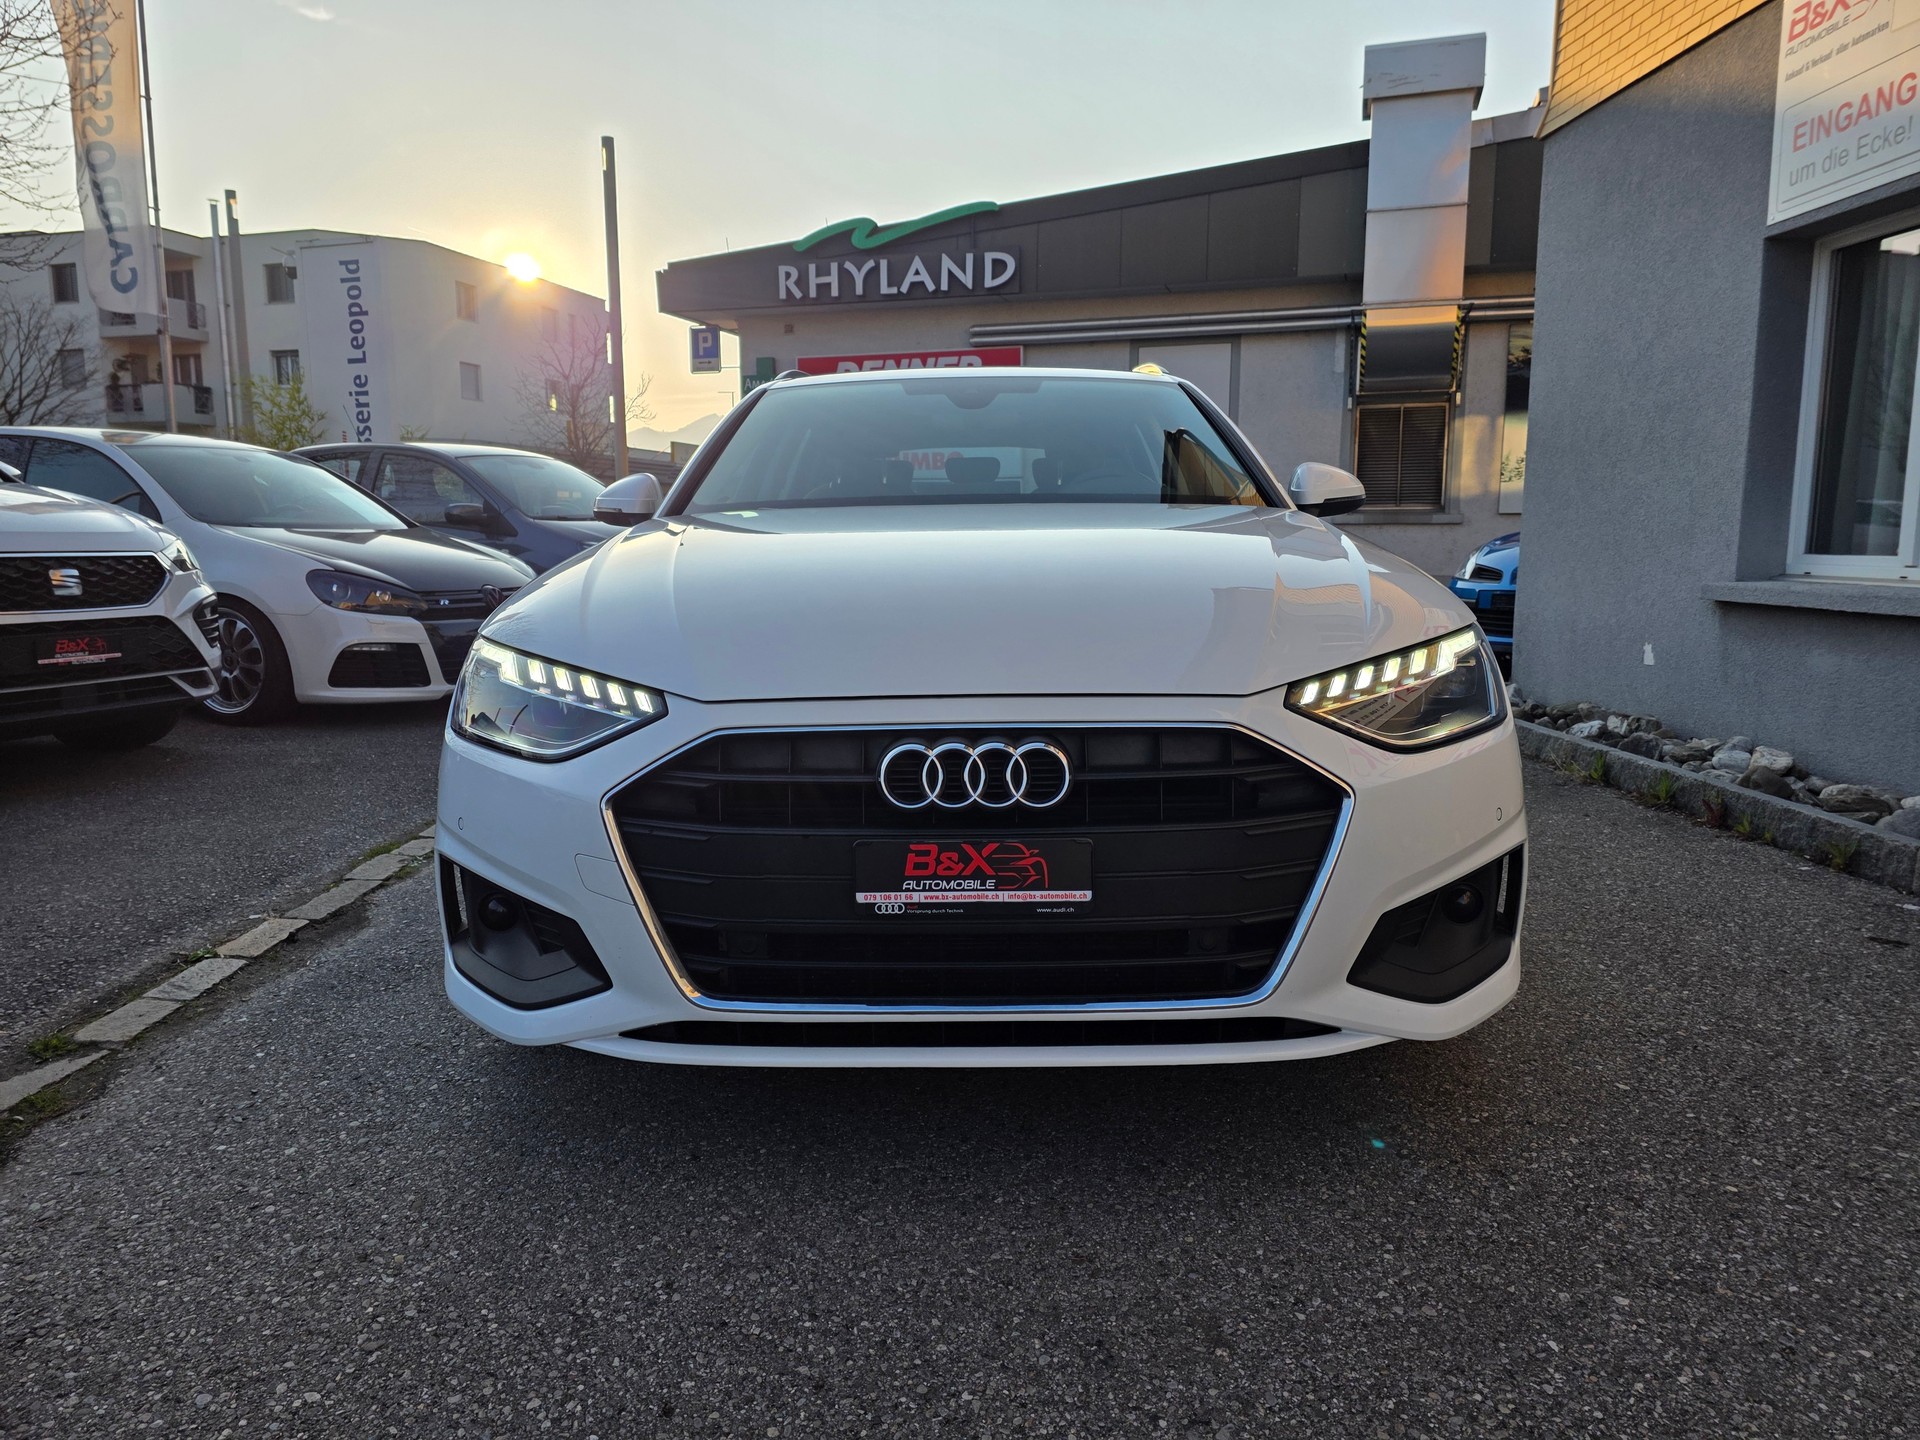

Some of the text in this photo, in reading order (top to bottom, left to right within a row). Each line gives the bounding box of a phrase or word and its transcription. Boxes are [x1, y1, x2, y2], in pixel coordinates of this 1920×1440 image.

[1784, 14, 1851, 59] AUTOMOBILE
[1810, 48, 1833, 70] Verkauf
[1851, 20, 1890, 48] Automarken
[1792, 72, 1918, 153] EINGANG
[1788, 114, 1914, 187] um die Ecke!
[777, 250, 1016, 300] RHYLAND
[338, 258, 369, 365] Leopold
[698, 331, 713, 356] P
[904, 842, 1001, 876] B&X
[863, 892, 1089, 902] 079 106 01 66 www.bx-automobile.ch info@bx-automobile.ch
[902, 879, 997, 890] AUTOMOBILE
[1036, 906, 1075, 914] www.audi.ch
